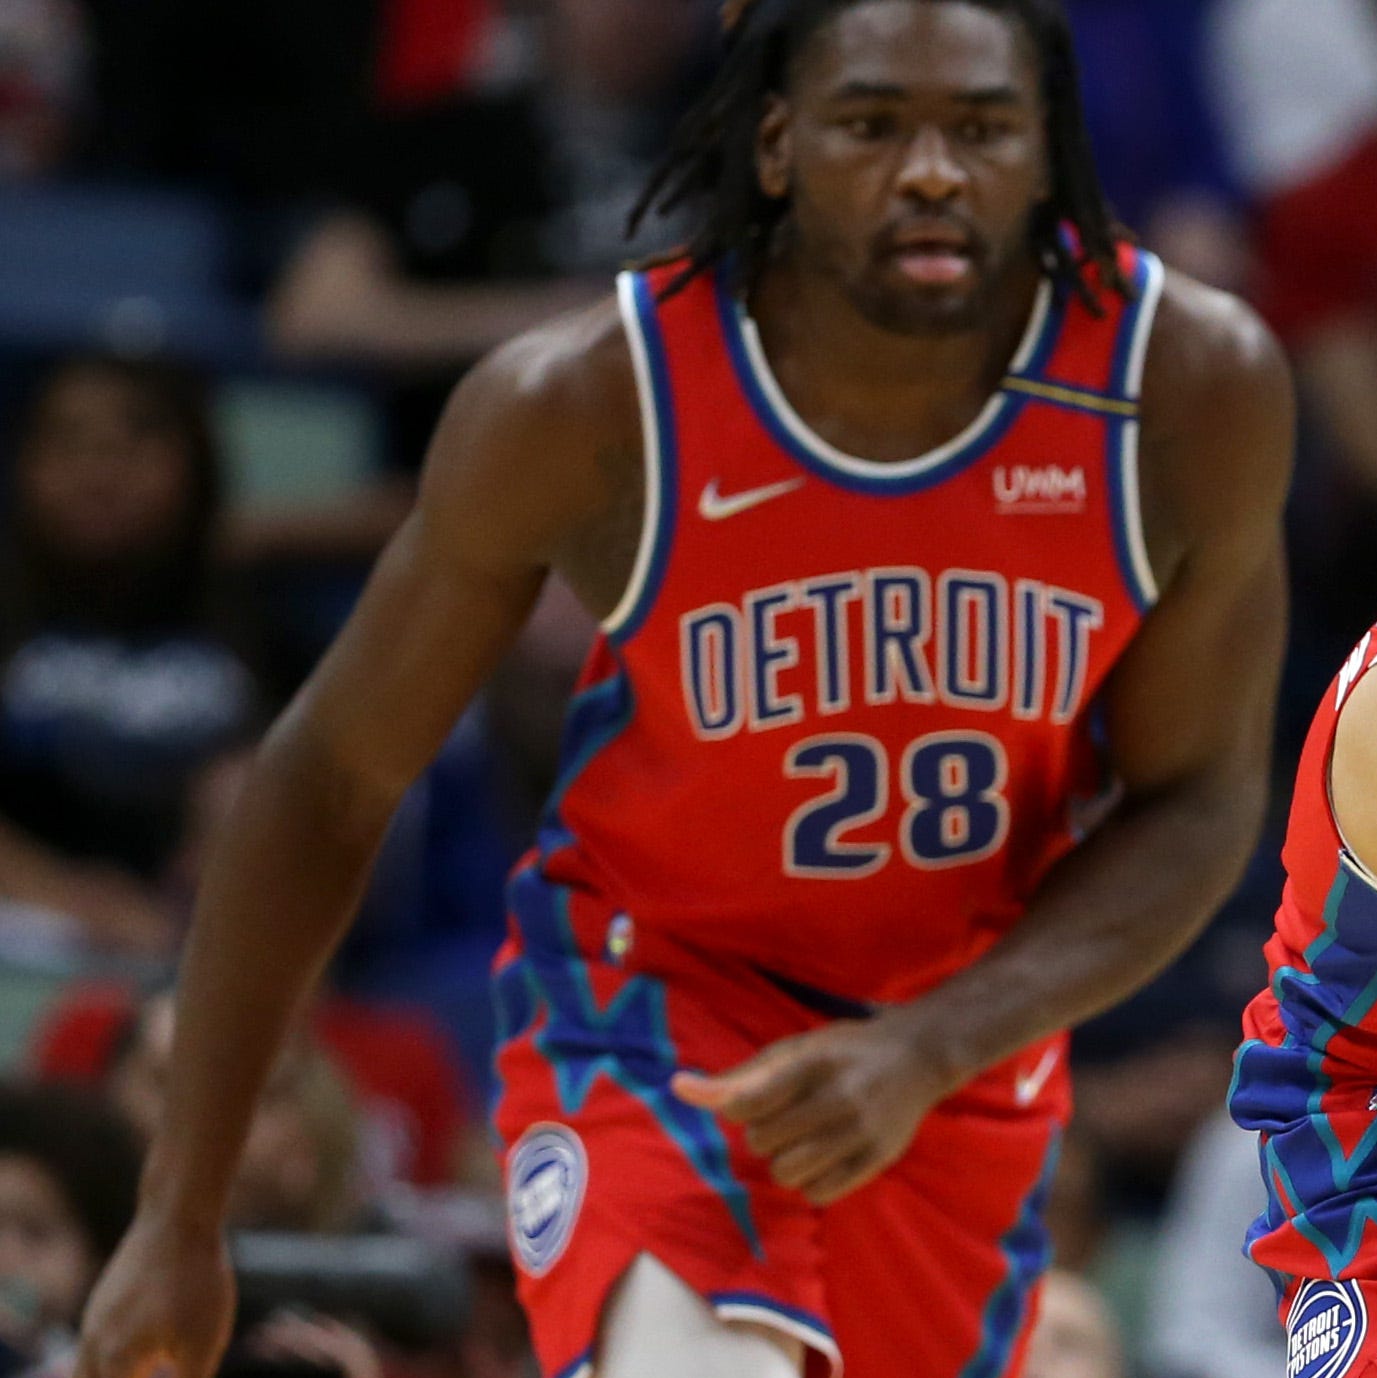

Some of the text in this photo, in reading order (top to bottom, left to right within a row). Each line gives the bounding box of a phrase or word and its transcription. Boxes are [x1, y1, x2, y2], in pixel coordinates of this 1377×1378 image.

[679, 565, 1104, 741] DETROIT
[781, 729, 1009, 880] 28
[1291, 1304, 1340, 1358] DETROIT
